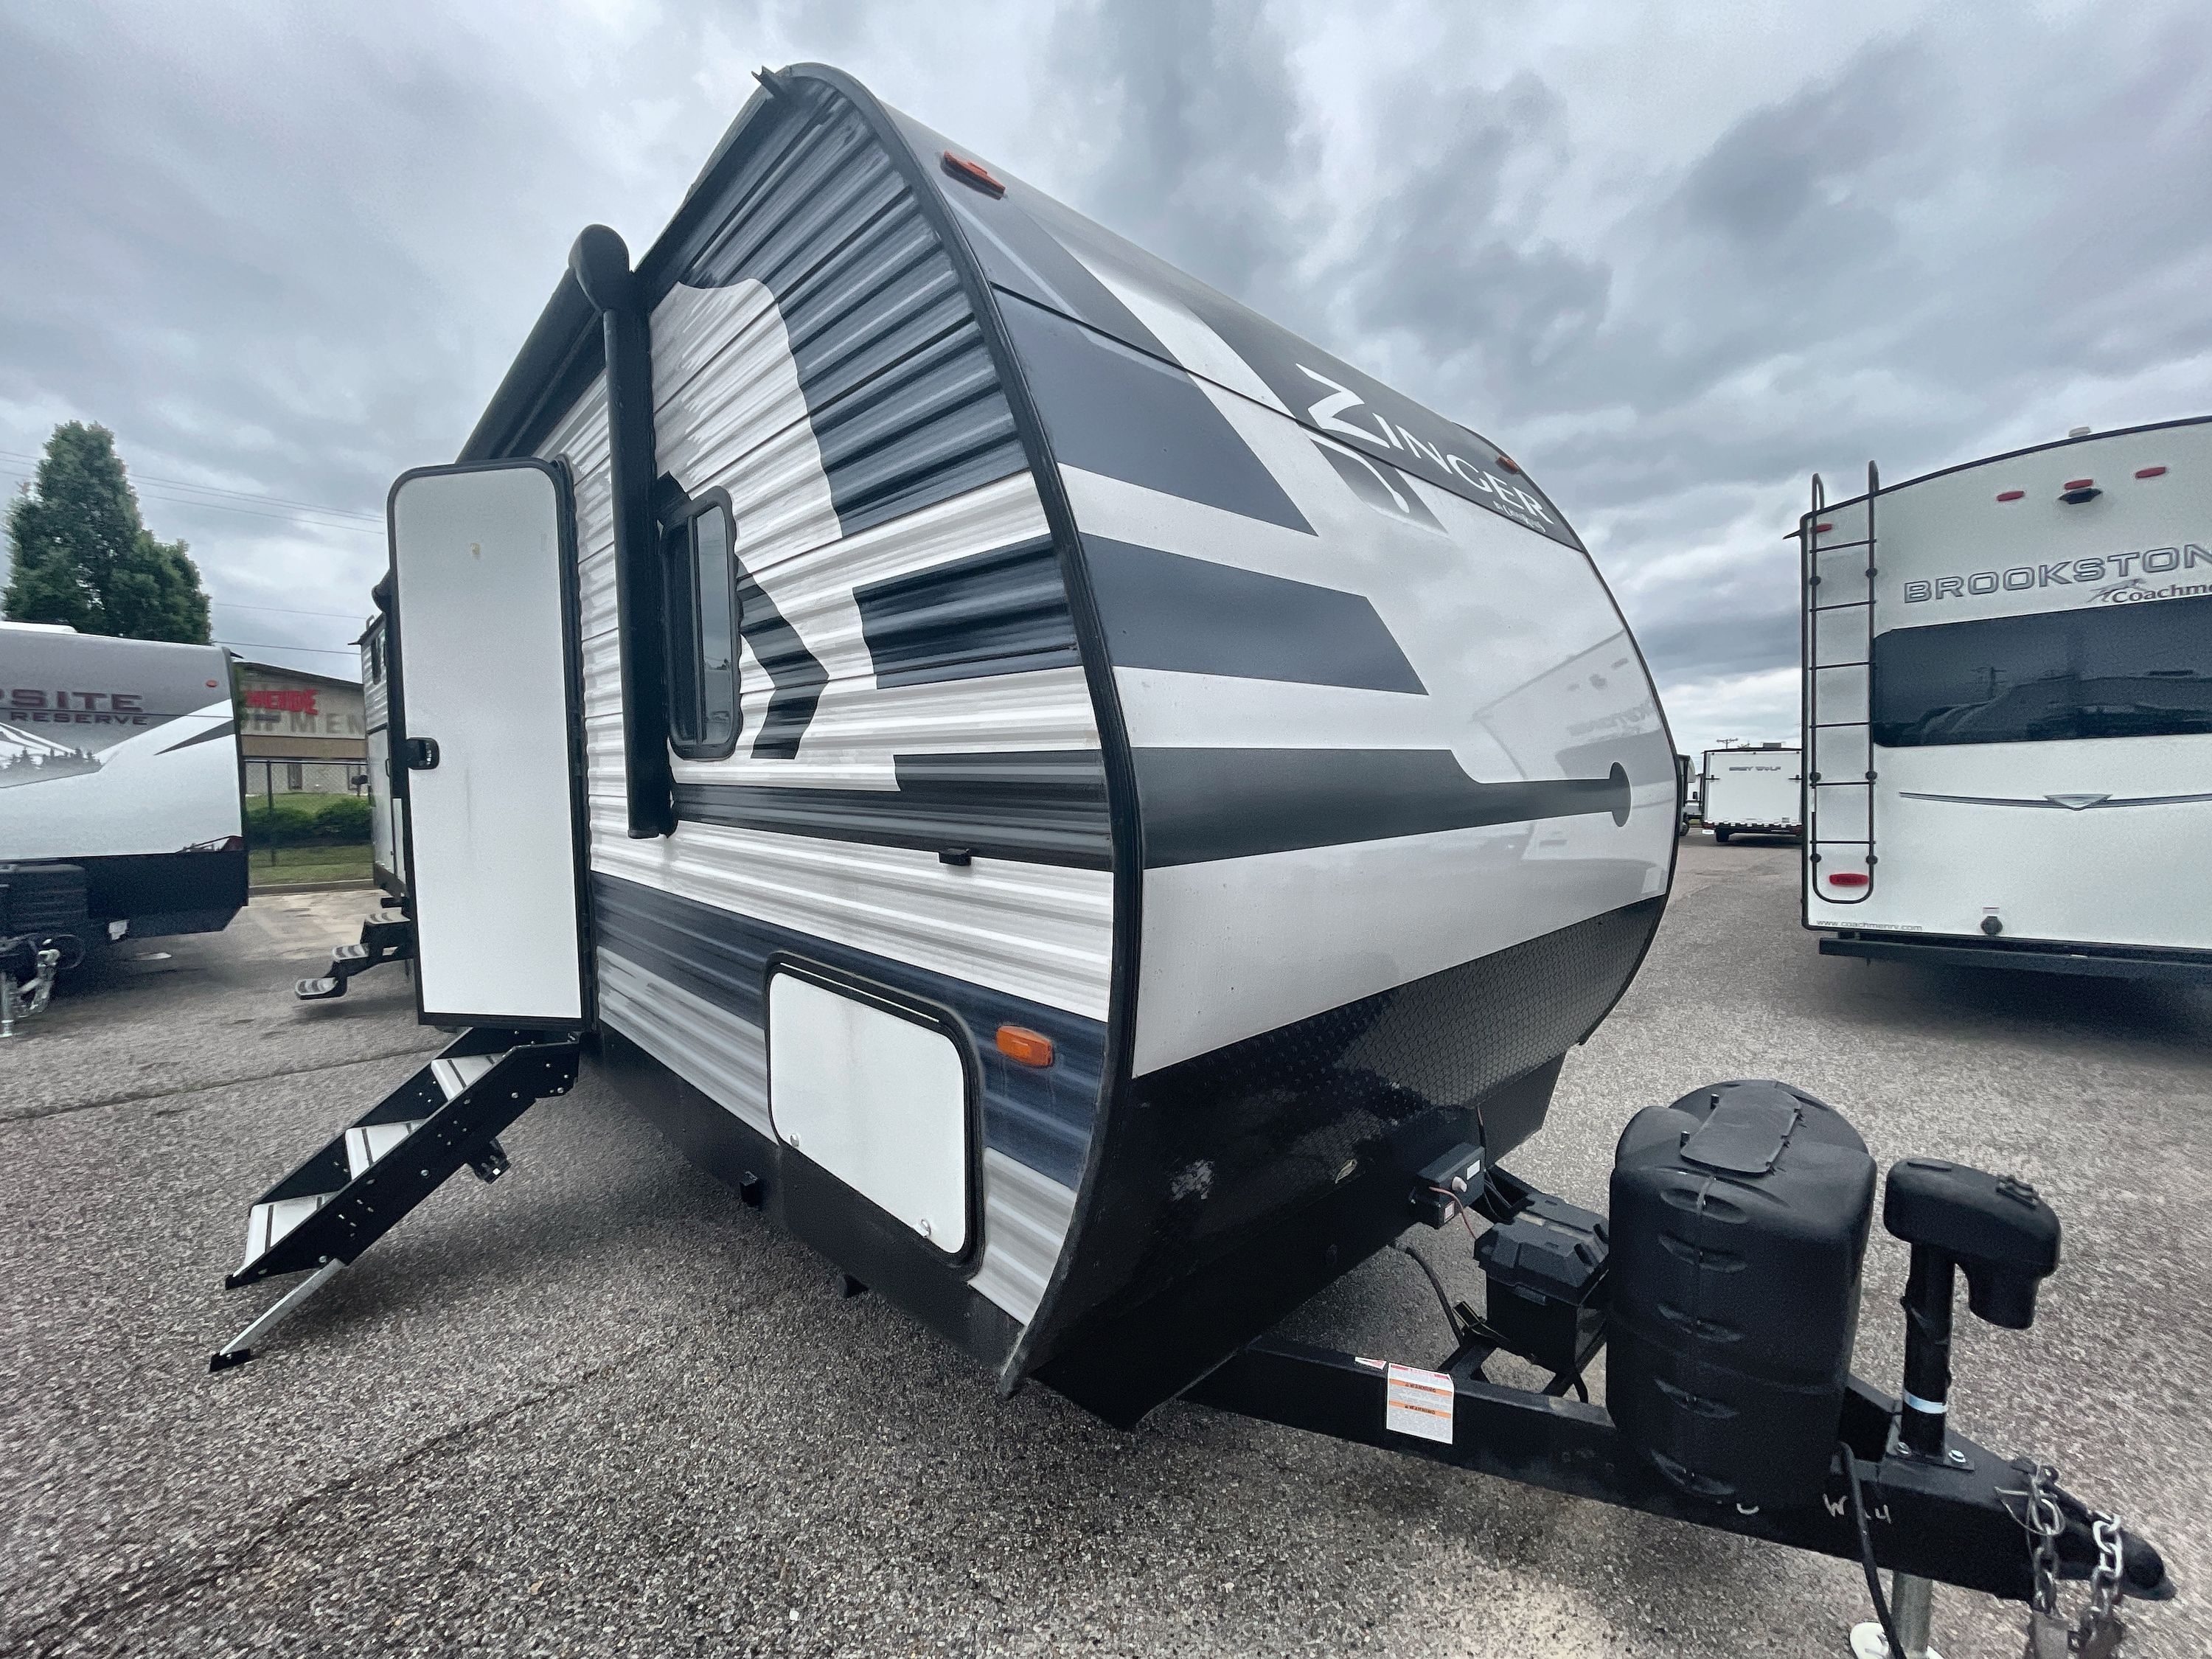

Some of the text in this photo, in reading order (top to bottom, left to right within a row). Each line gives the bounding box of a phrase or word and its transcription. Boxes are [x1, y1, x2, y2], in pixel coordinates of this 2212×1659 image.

[1295, 363, 1555, 524] ZINGER
[1904, 543, 2212, 603] BROOKSTON
[2112, 584, 2212, 603] Coachm
[0, 689, 143, 713] SITE
[10, 711, 148, 726] RESERVE
